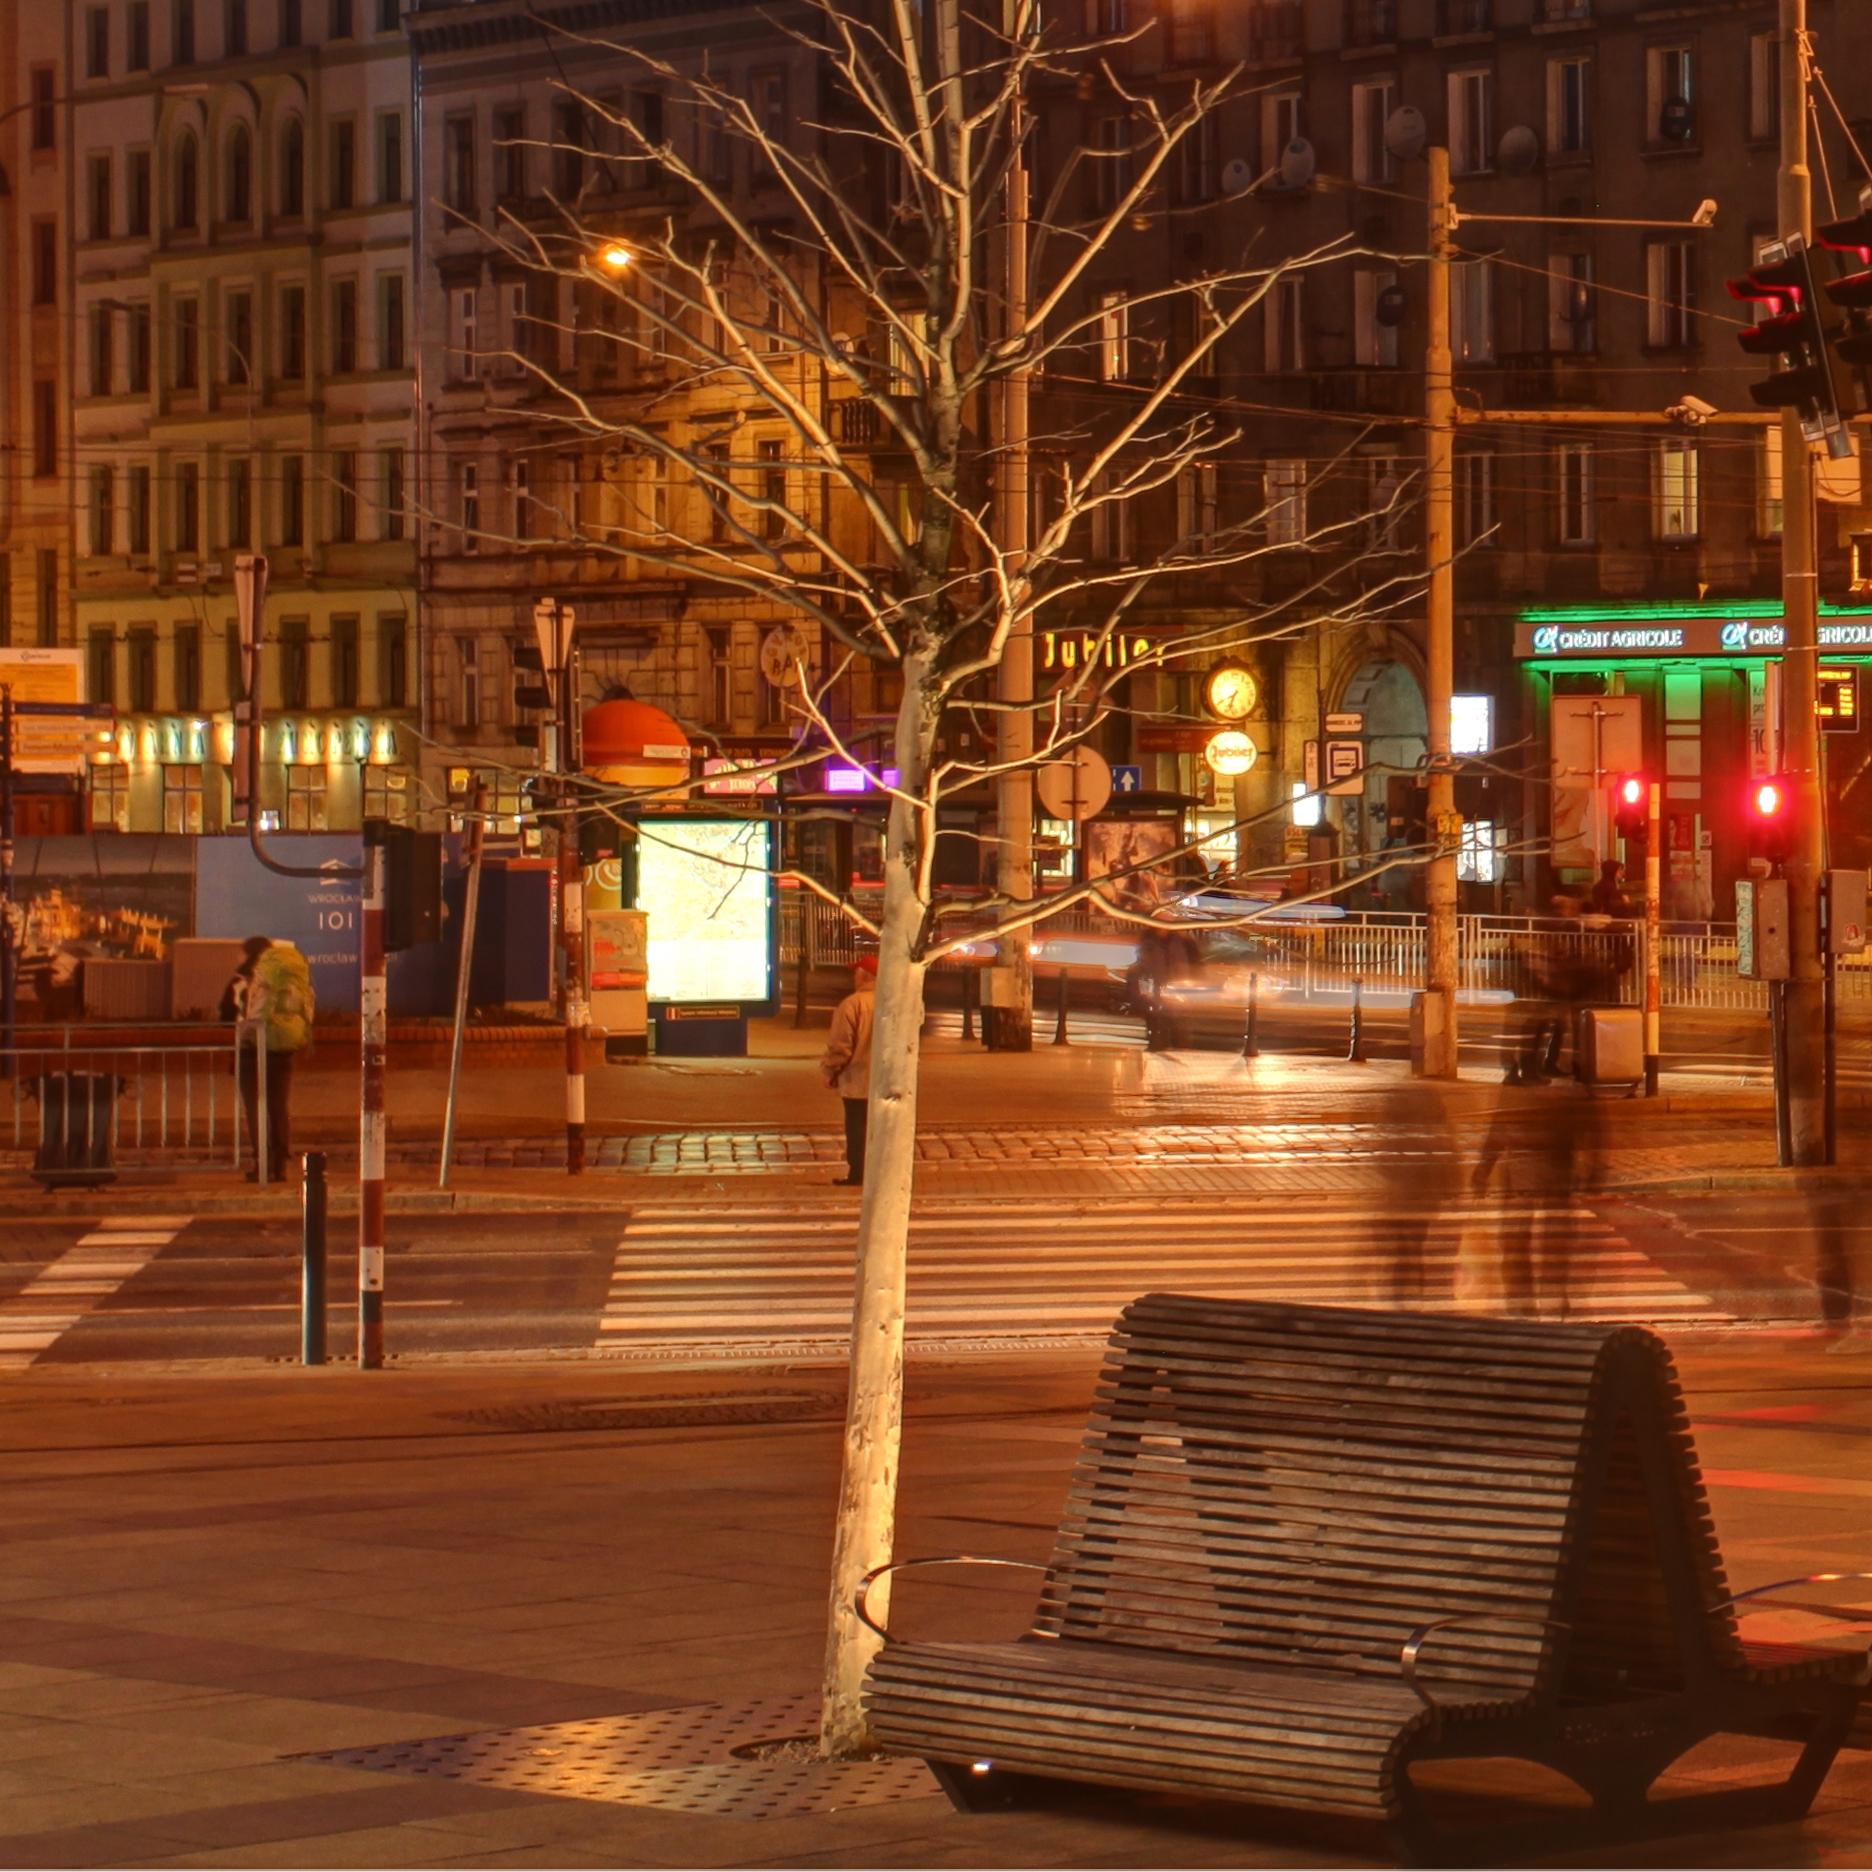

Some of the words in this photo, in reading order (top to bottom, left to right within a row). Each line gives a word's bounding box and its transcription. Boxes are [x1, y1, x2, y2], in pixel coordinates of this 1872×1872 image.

[1559, 629, 1609, 649] CRÉDIT
[1610, 629, 1683, 647] AGRICOLE
[1043, 633, 1166, 668] Jubiler
[1210, 744, 1254, 766] Jubiler
